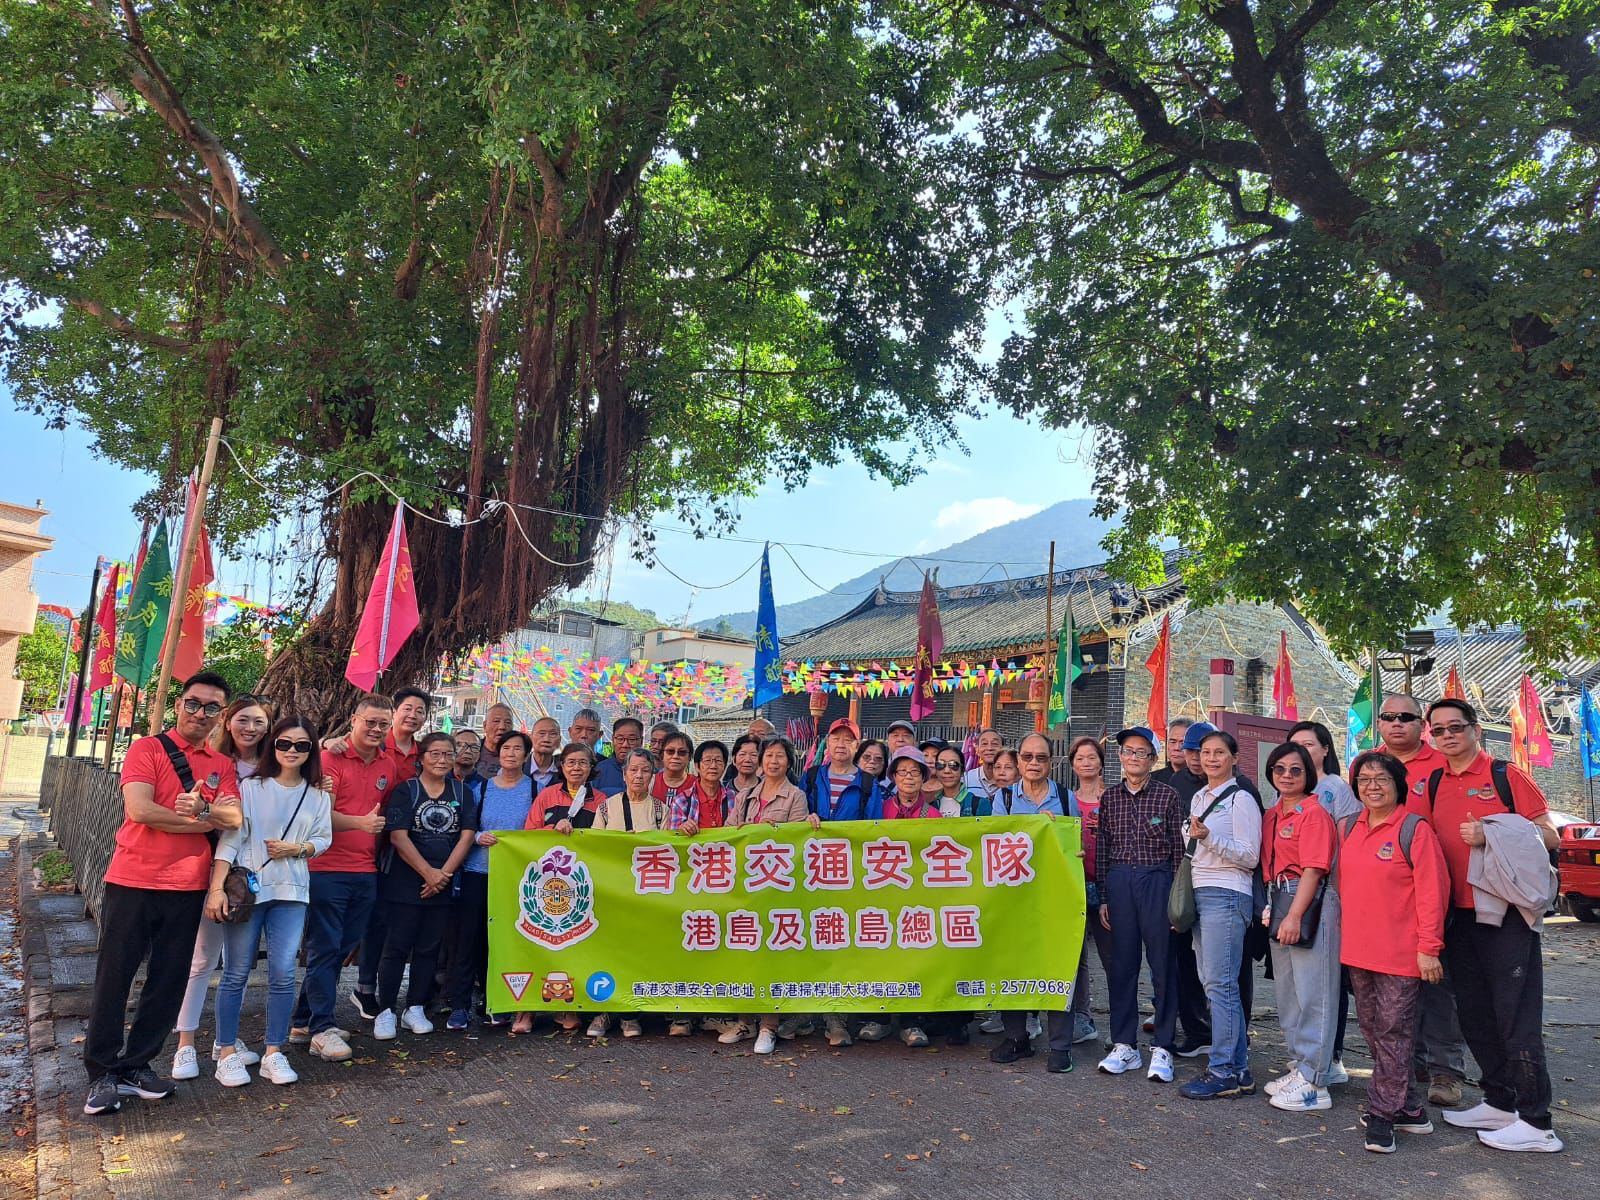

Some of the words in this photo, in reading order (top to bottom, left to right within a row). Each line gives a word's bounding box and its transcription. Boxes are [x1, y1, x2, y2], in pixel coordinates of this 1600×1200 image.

[634, 836, 1034, 893] 香港交通安全隊
[543, 933, 571, 943] SAFETY
[683, 909, 981, 947] 港島及離島總區
[509, 975, 526, 983] GIVE
